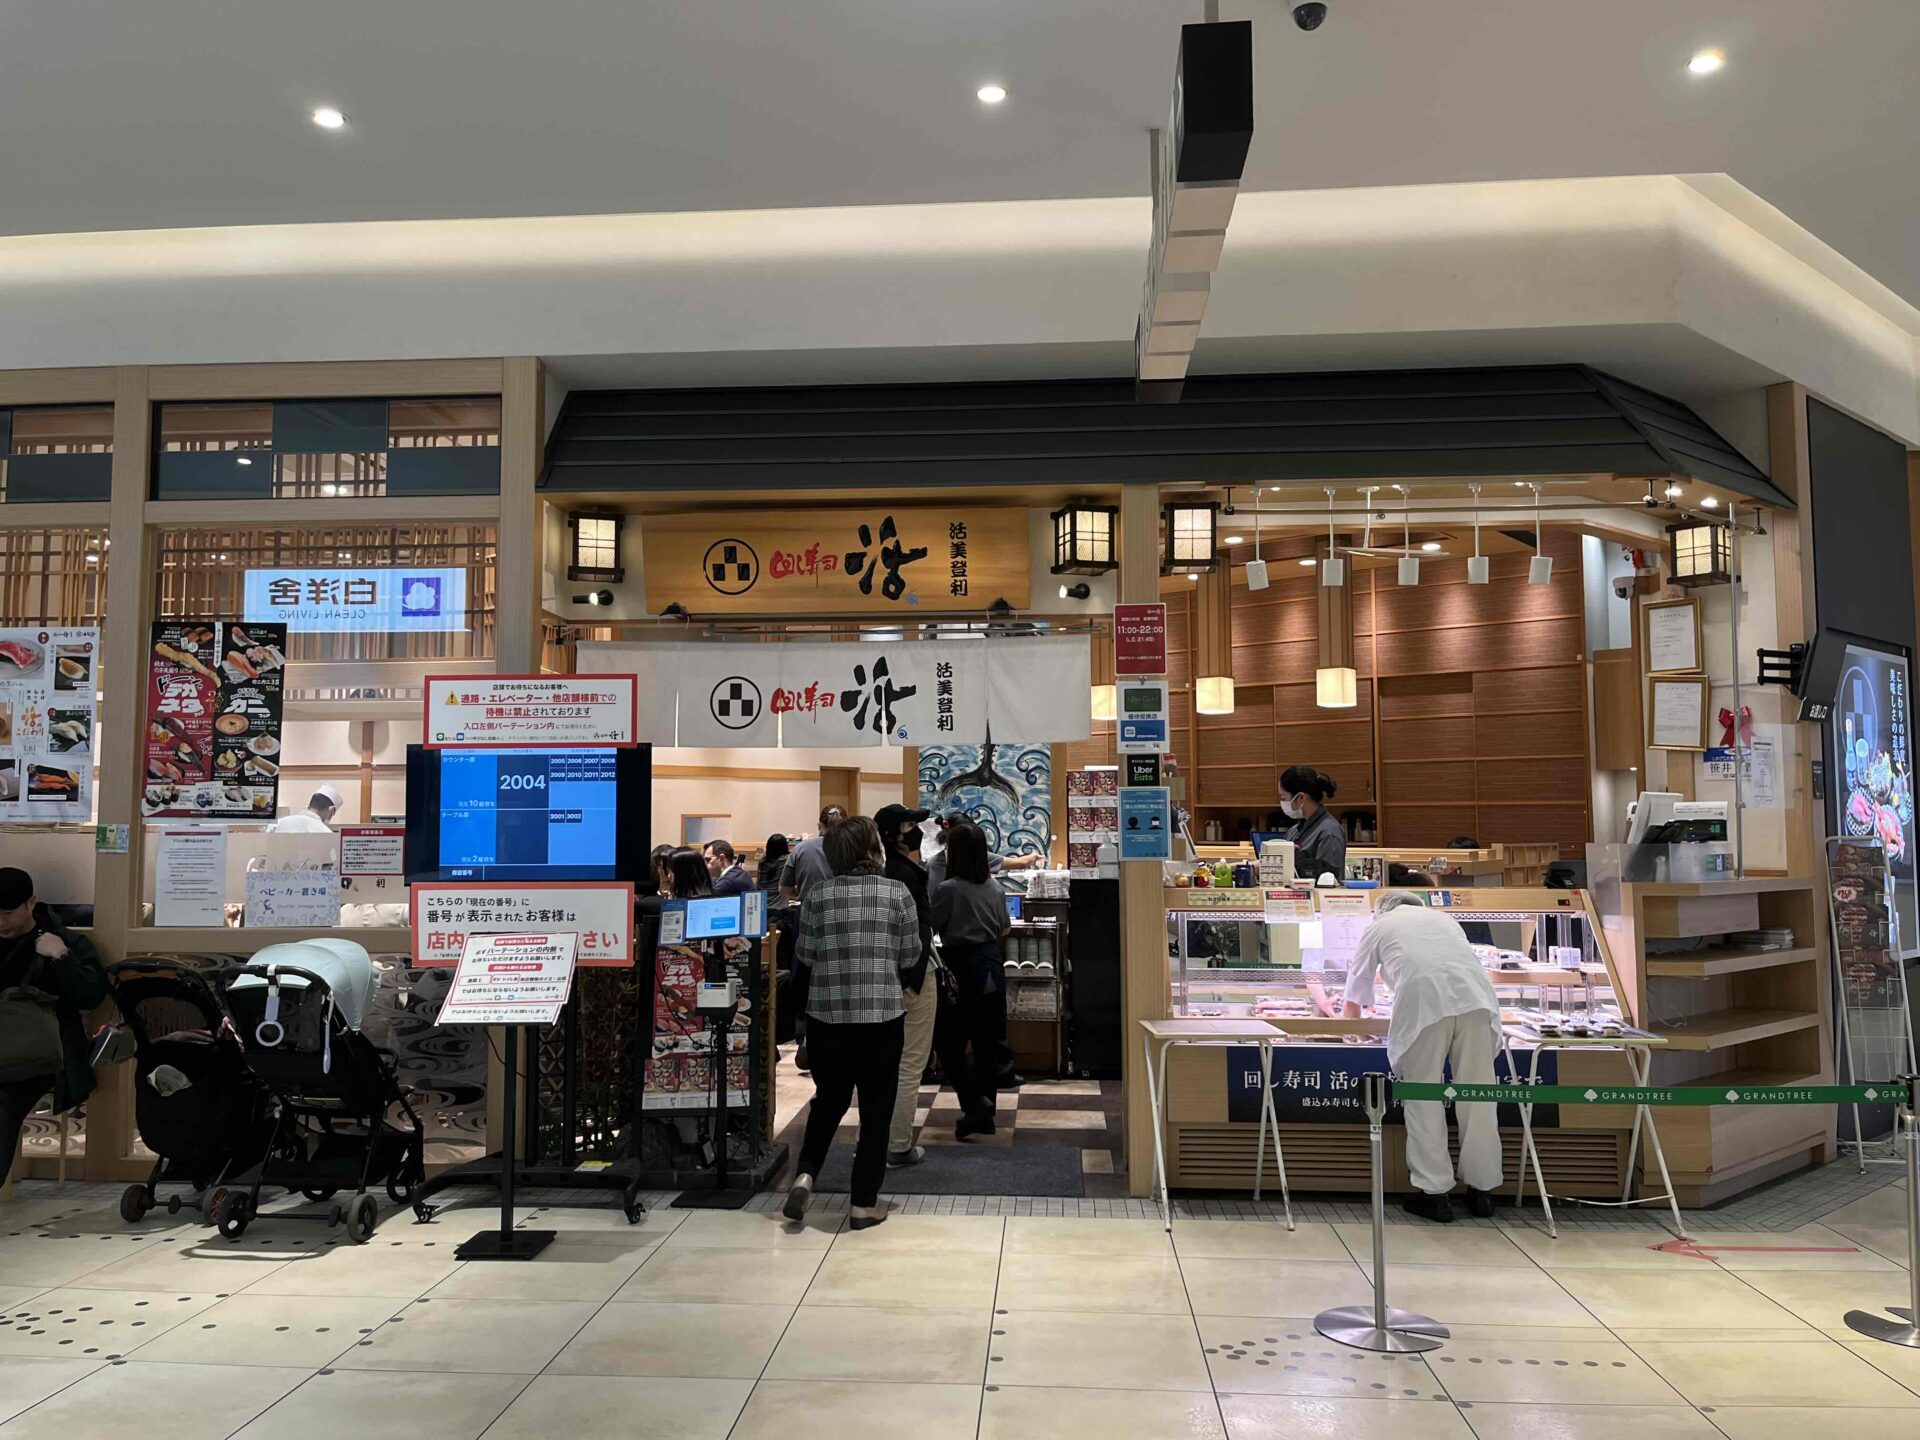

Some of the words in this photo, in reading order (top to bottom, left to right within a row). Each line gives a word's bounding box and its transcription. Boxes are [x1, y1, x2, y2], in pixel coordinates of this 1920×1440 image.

[844, 515, 928, 600] 活
[949, 522, 969, 597] 活美登利
[839, 656, 917, 735] 活
[936, 662, 954, 731] 活美登利
[223, 698, 271, 713] カニ
[485, 707, 592, 717] 待機は禁止されております
[500, 774, 546, 790] 2004
[259, 888, 327, 897] ベビーカー置き場
[427, 897, 530, 907] こちらの「現在の番号」に
[427, 909, 577, 923] 番号が表示されたお客様は
[1461, 1089, 1531, 1099] GRANDTREE
[1602, 1091, 1673, 1101] GRANDTREE
[1743, 1091, 1813, 1100] GRANDTREE
